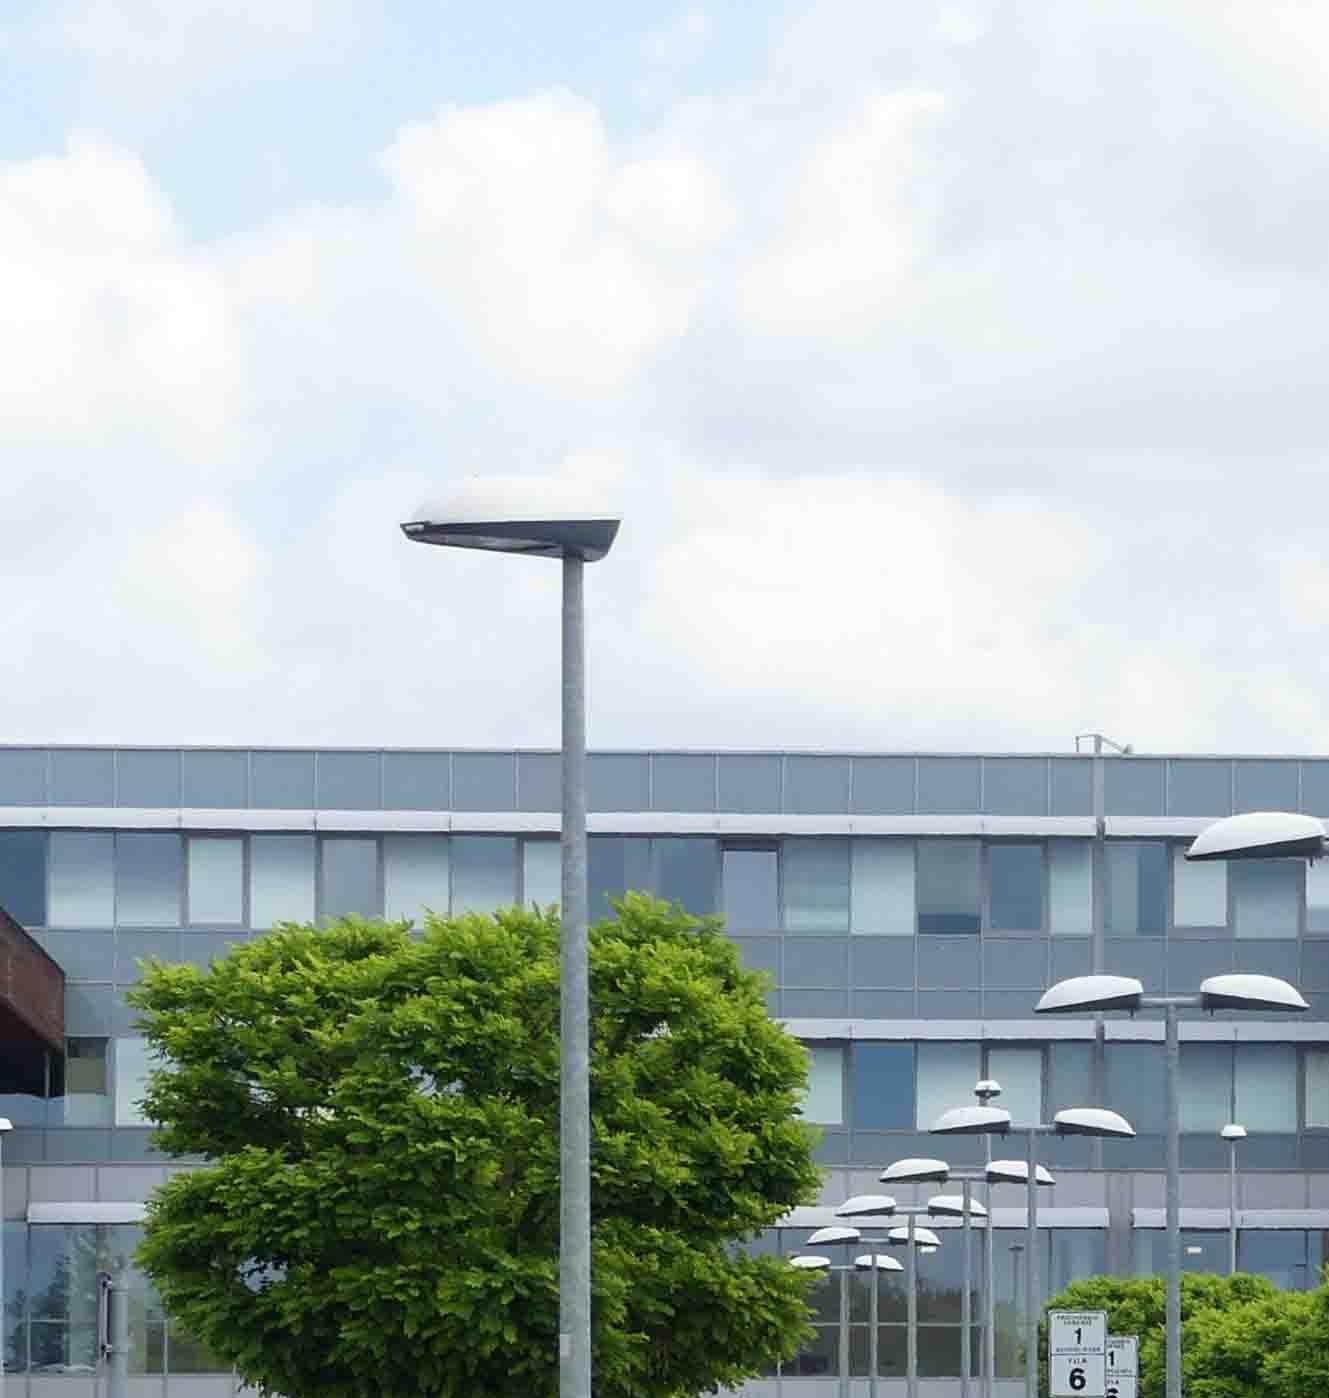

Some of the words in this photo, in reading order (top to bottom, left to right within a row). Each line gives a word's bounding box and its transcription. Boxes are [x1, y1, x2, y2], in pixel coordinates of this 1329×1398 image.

[1075, 1327, 1081, 1345] 1
[1108, 1350, 1116, 1366] 1
[1069, 1367, 1086, 1391] 6
